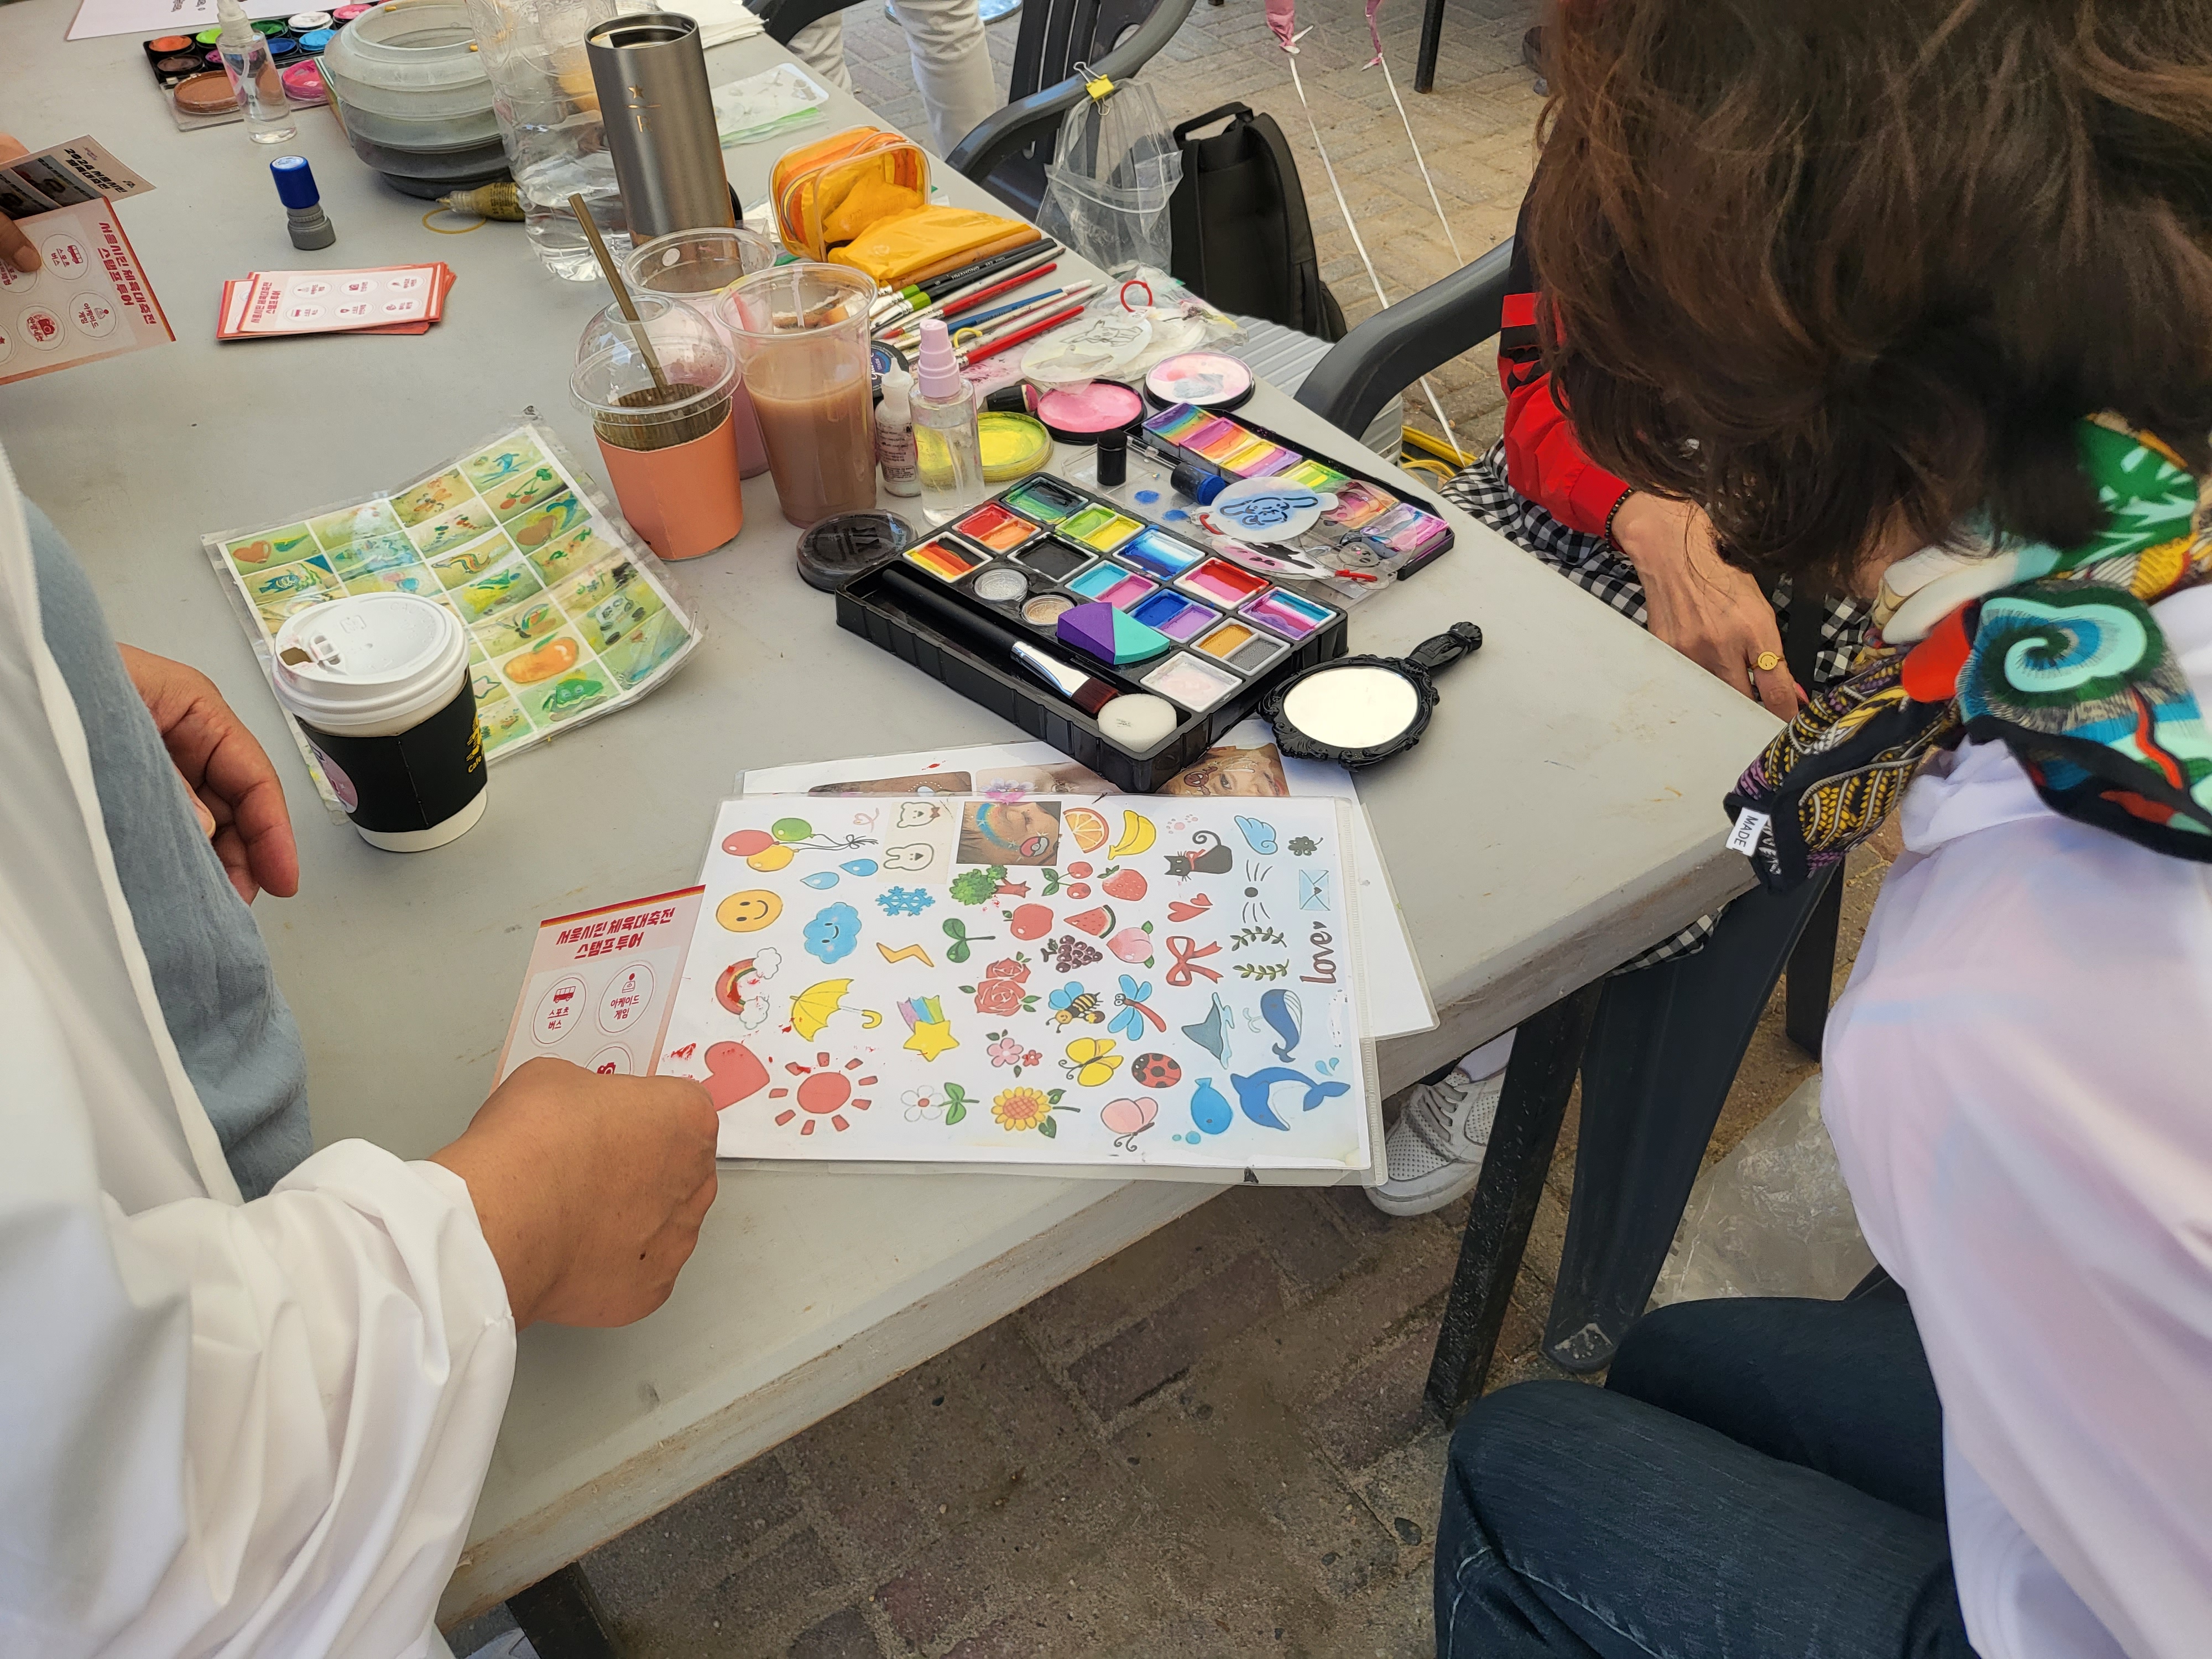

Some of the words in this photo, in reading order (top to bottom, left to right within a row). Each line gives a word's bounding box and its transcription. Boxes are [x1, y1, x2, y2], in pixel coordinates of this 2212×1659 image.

[64, 148, 95, 170] 2024
[116, 284, 134, 305] 투어
[1734, 815, 1759, 848] MADE
[607, 907, 676, 935] 체육대축전
[574, 938, 616, 959] 스탬프
[615, 932, 644, 950] 투어
[547, 1006, 569, 1019] 스포츠
[611, 995, 640, 1009] 아케이드
[613, 1008, 629, 1020] 게임
[548, 1020, 562, 1030] 버스
